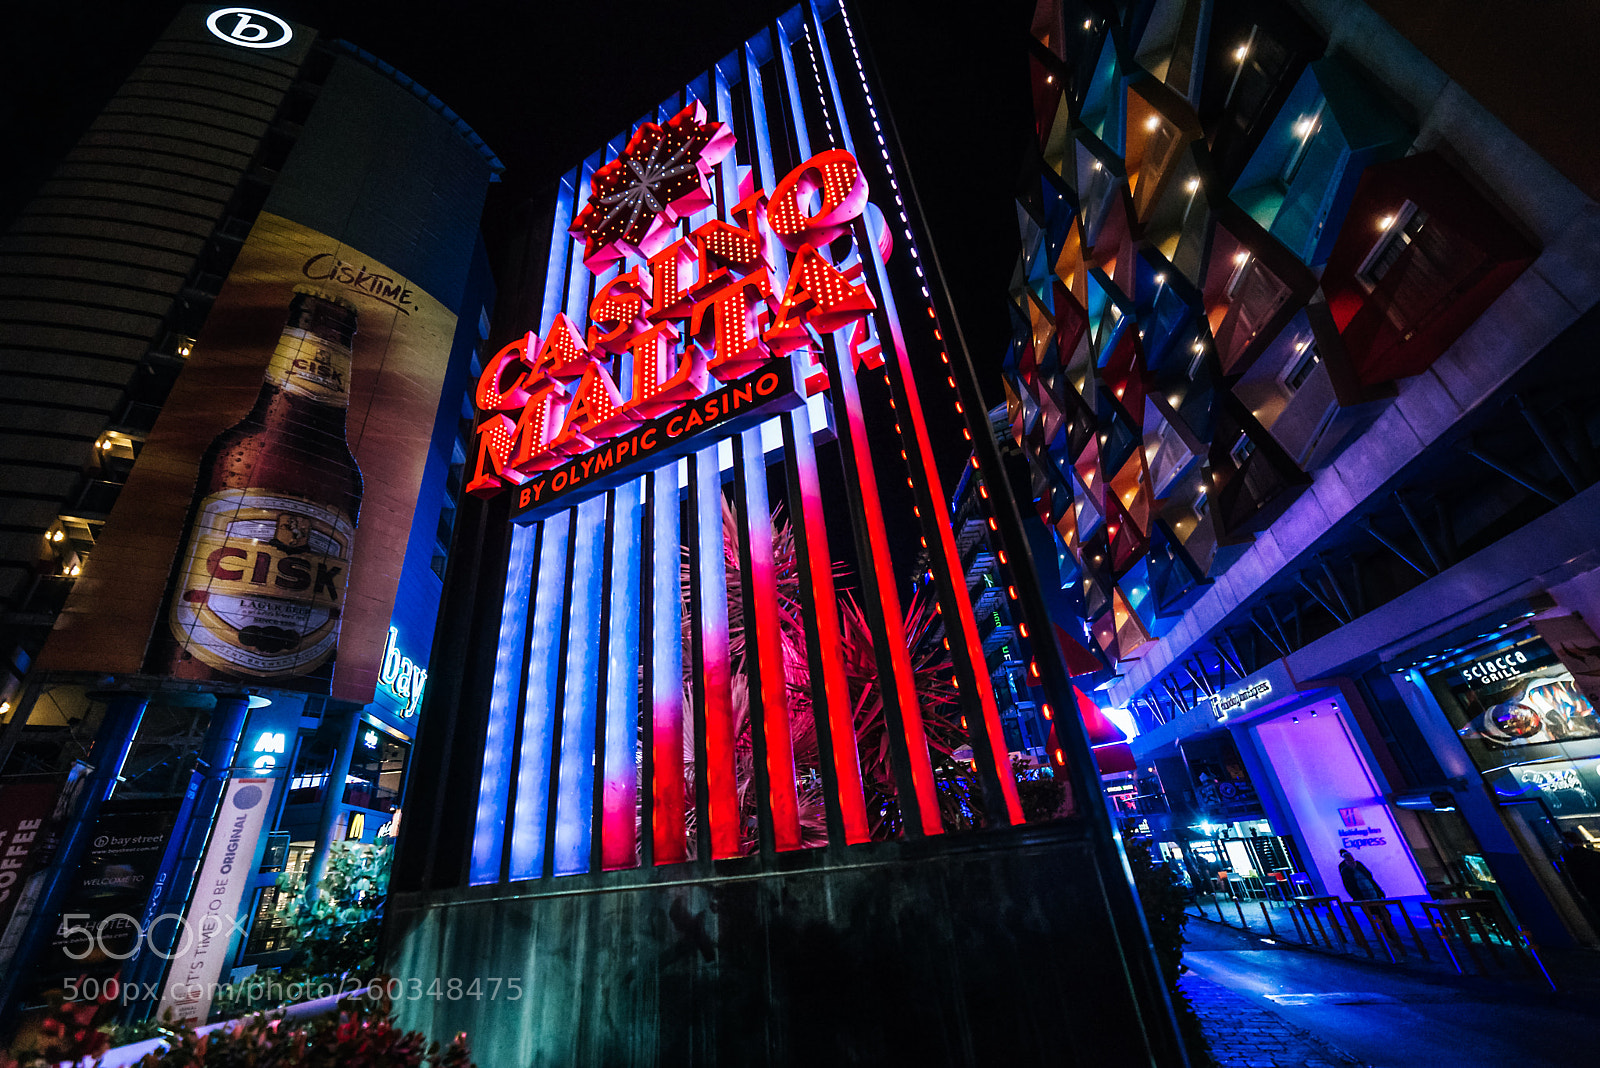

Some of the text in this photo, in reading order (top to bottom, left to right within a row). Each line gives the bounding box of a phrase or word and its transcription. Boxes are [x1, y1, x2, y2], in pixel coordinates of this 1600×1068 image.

[476, 149, 869, 412] CASINO
[292, 358, 343, 385] CISK
[466, 243, 877, 494] MALTA
[518, 372, 779, 509] BY OLYMPIC CASINO
[206, 547, 342, 601] CISK
[240, 600, 281, 612] LAGER
[378, 626, 428, 719] bay
[1481, 666, 1521, 685] GRILL
[110, 836, 131, 847] bay
[132, 834, 164, 844] street
[219, 813, 248, 875] ORIGINAL
[1342, 837, 1387, 850] Express
[83, 876, 130, 886] WELCOME
[213, 878, 229, 897] BE
[194, 922, 216, 957] TIME
